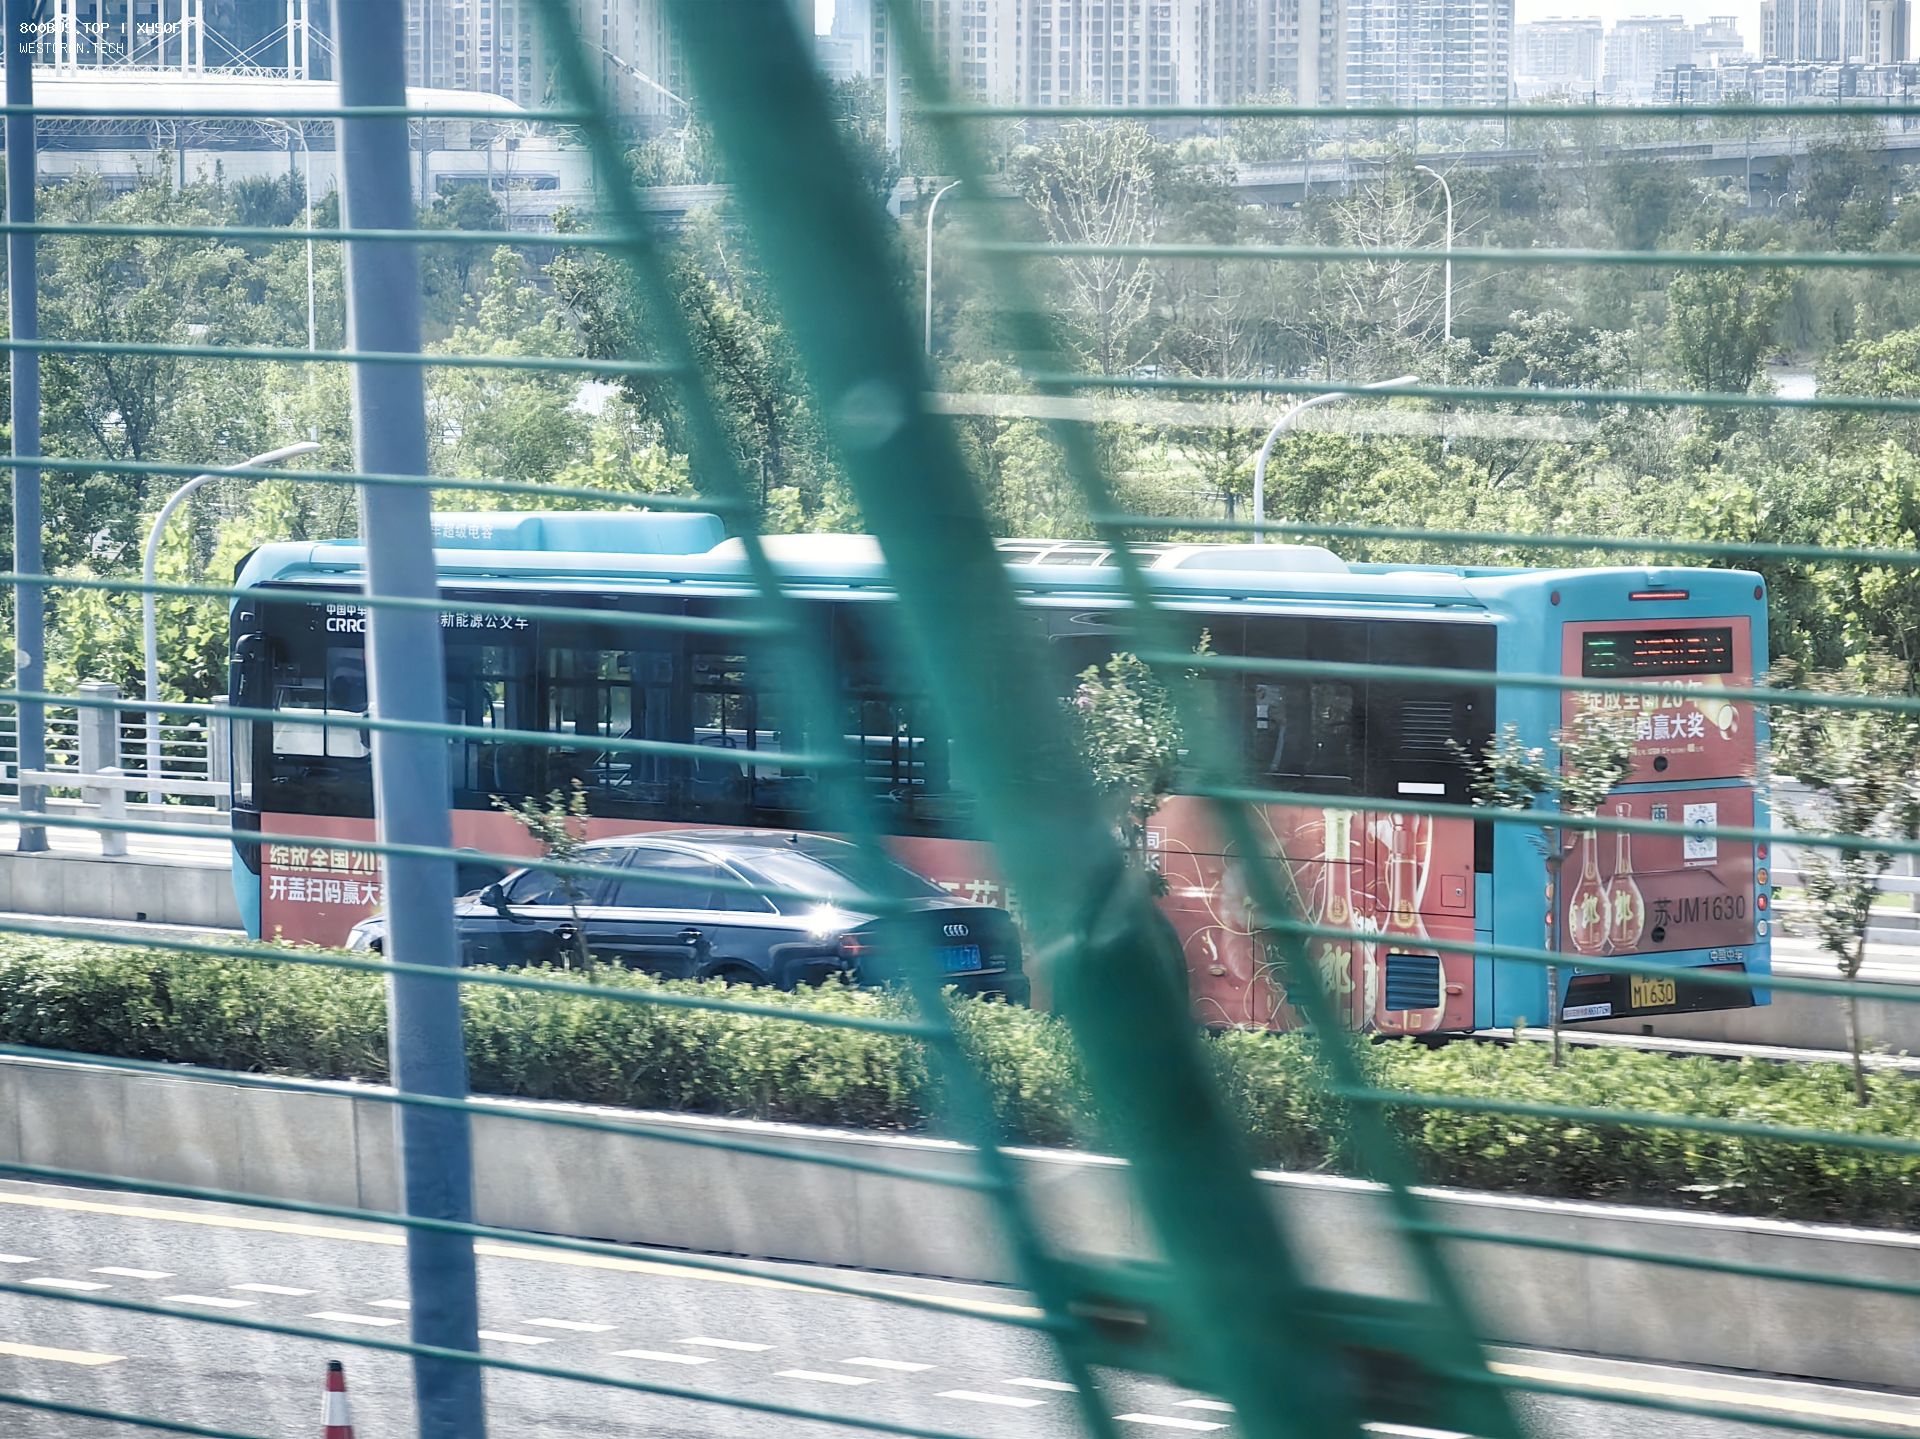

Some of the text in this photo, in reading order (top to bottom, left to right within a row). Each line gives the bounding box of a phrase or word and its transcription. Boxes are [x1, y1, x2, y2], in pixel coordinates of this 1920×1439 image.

[326, 617, 367, 633] CRRC
[1652, 895, 1746, 928] 苏JM1630
[1634, 983, 1673, 1006] M1630
